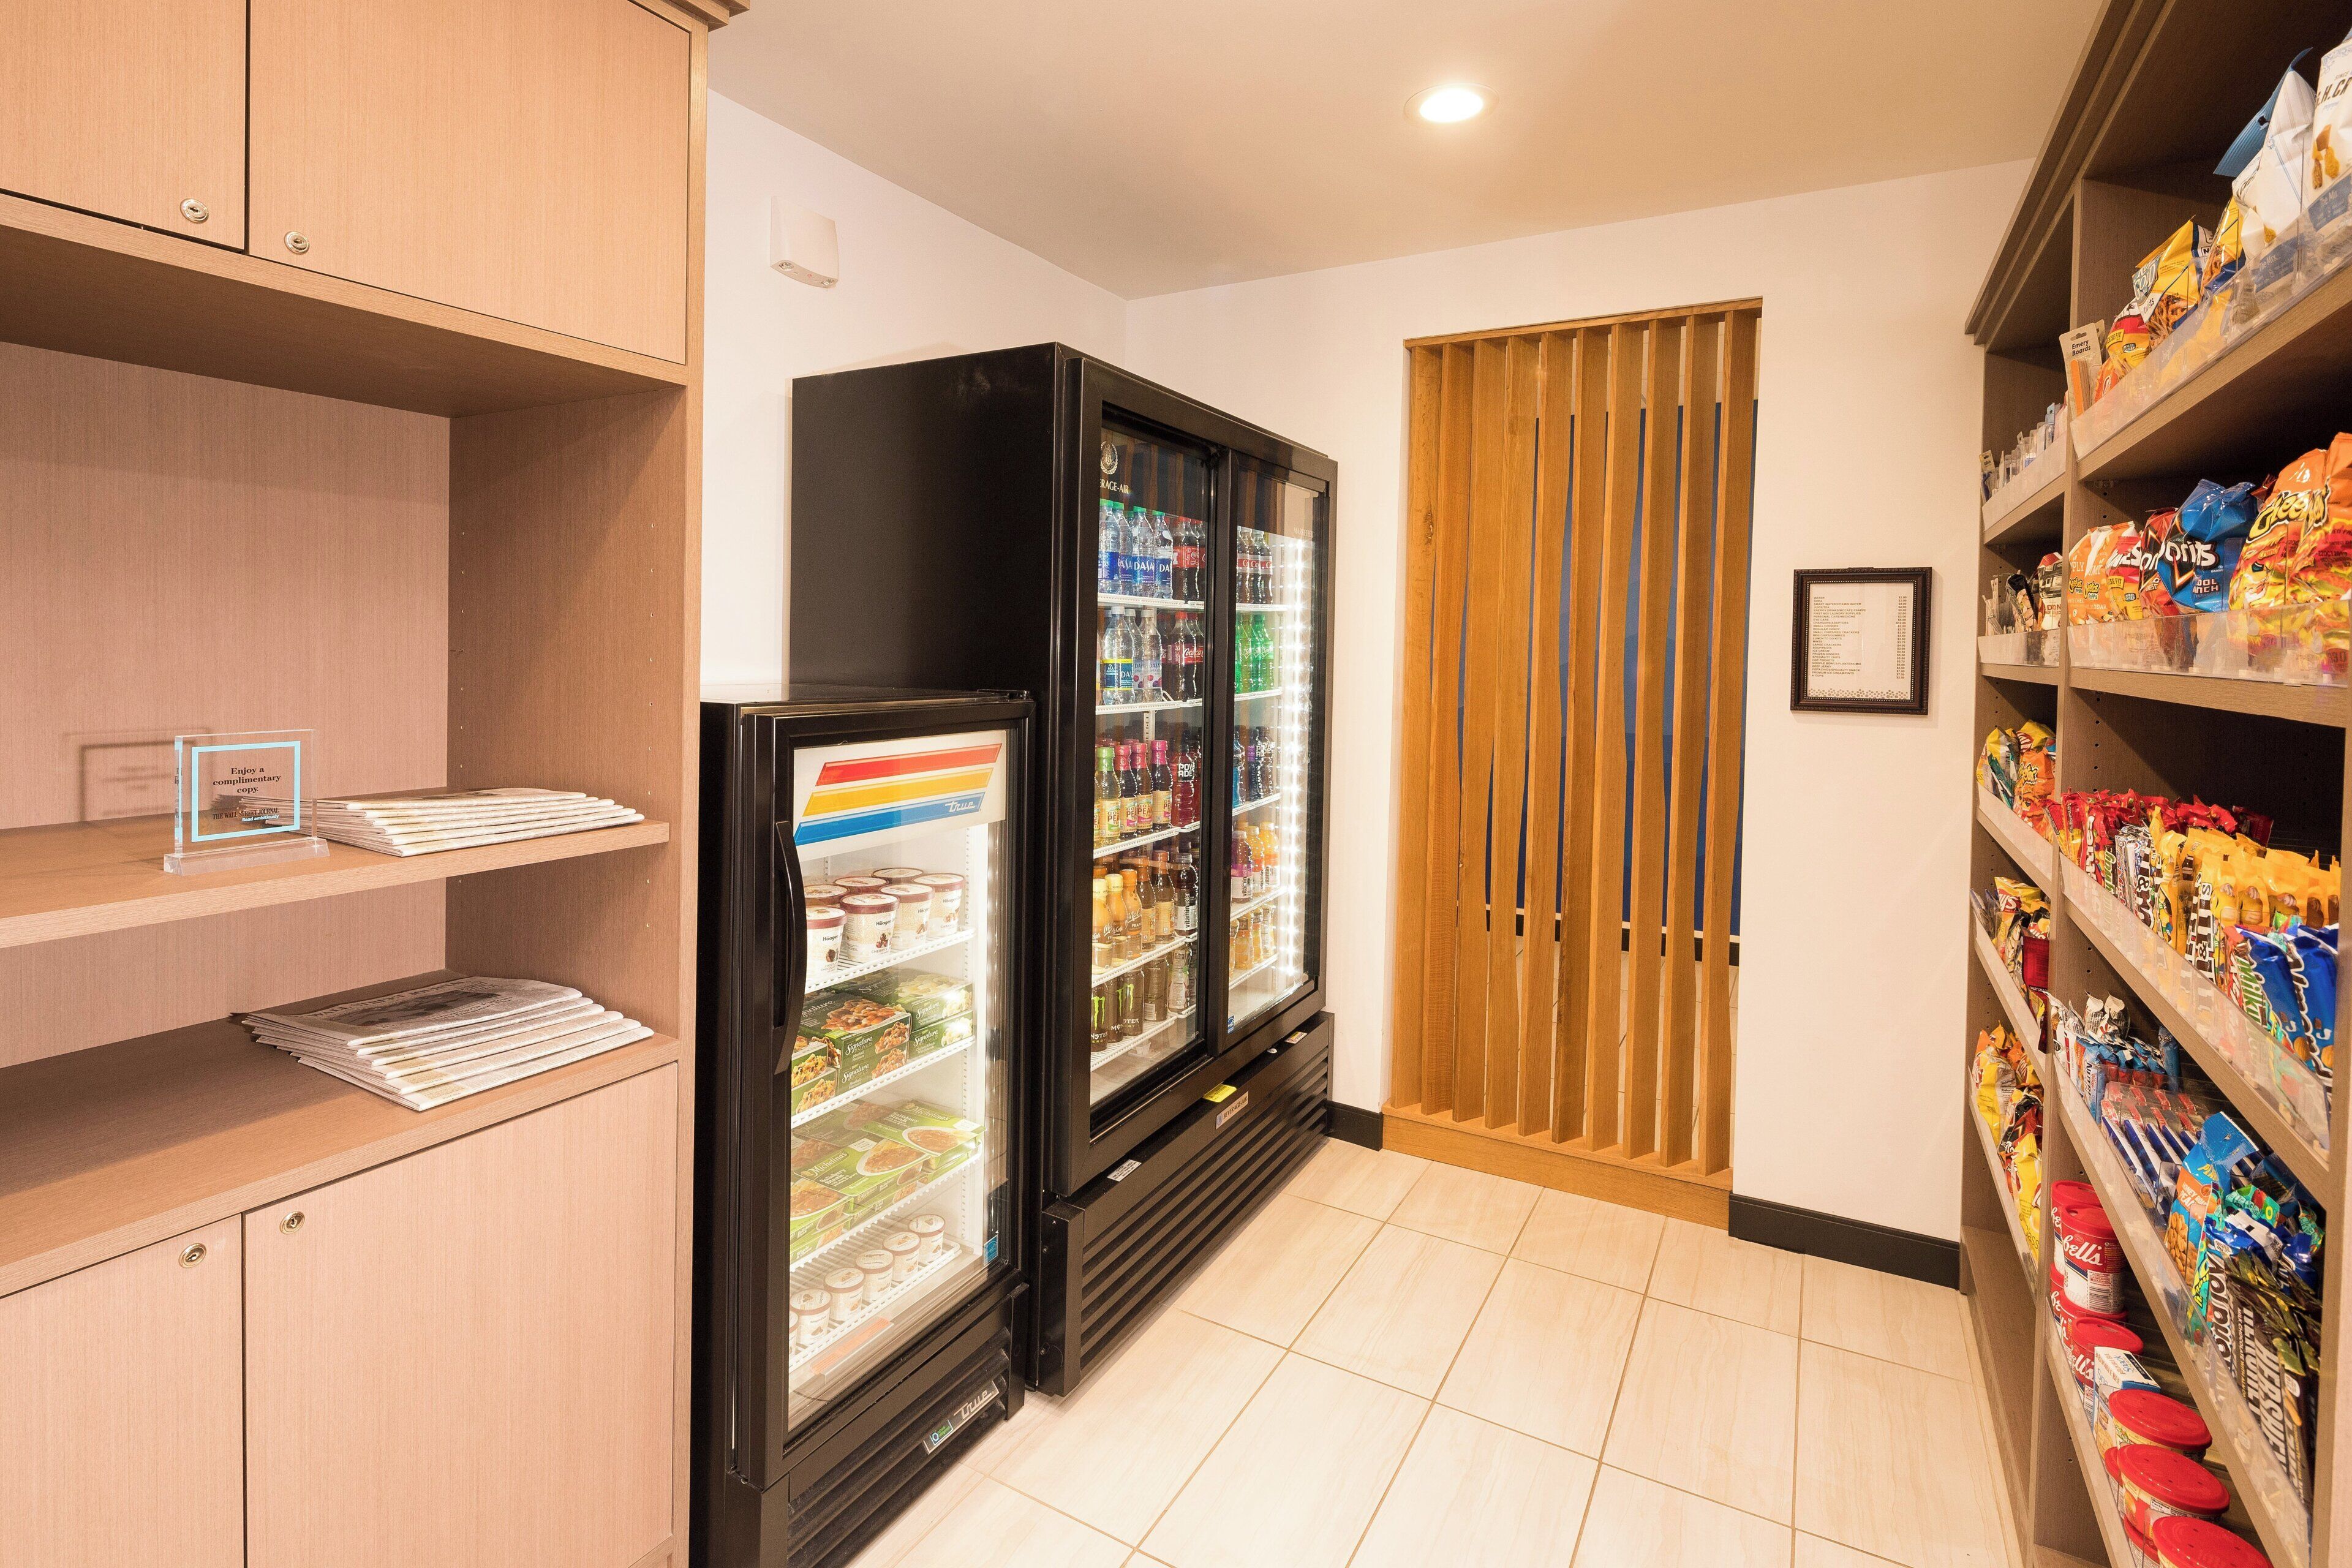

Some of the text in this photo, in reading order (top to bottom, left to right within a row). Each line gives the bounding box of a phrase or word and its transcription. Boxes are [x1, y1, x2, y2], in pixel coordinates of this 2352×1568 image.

[2071, 339, 2090, 350] Emery
[2071, 345, 2092, 356] Boards
[231, 766, 257, 776] Enjoy
[213, 775, 281, 786] complimentary
[916, 1002, 940, 1019] Signature
[913, 1030, 938, 1047] Signature
[845, 1036, 873, 1055] Signature
[842, 1064, 869, 1083] Signature
[1223, 1096, 1248, 1120] BEVERAGE-AIR
[889, 1114, 907, 1123] Steak
[892, 1112, 918, 1123] Salisbury
[819, 1169, 846, 1183] Salisbury
[825, 1174, 845, 1185] Steak
